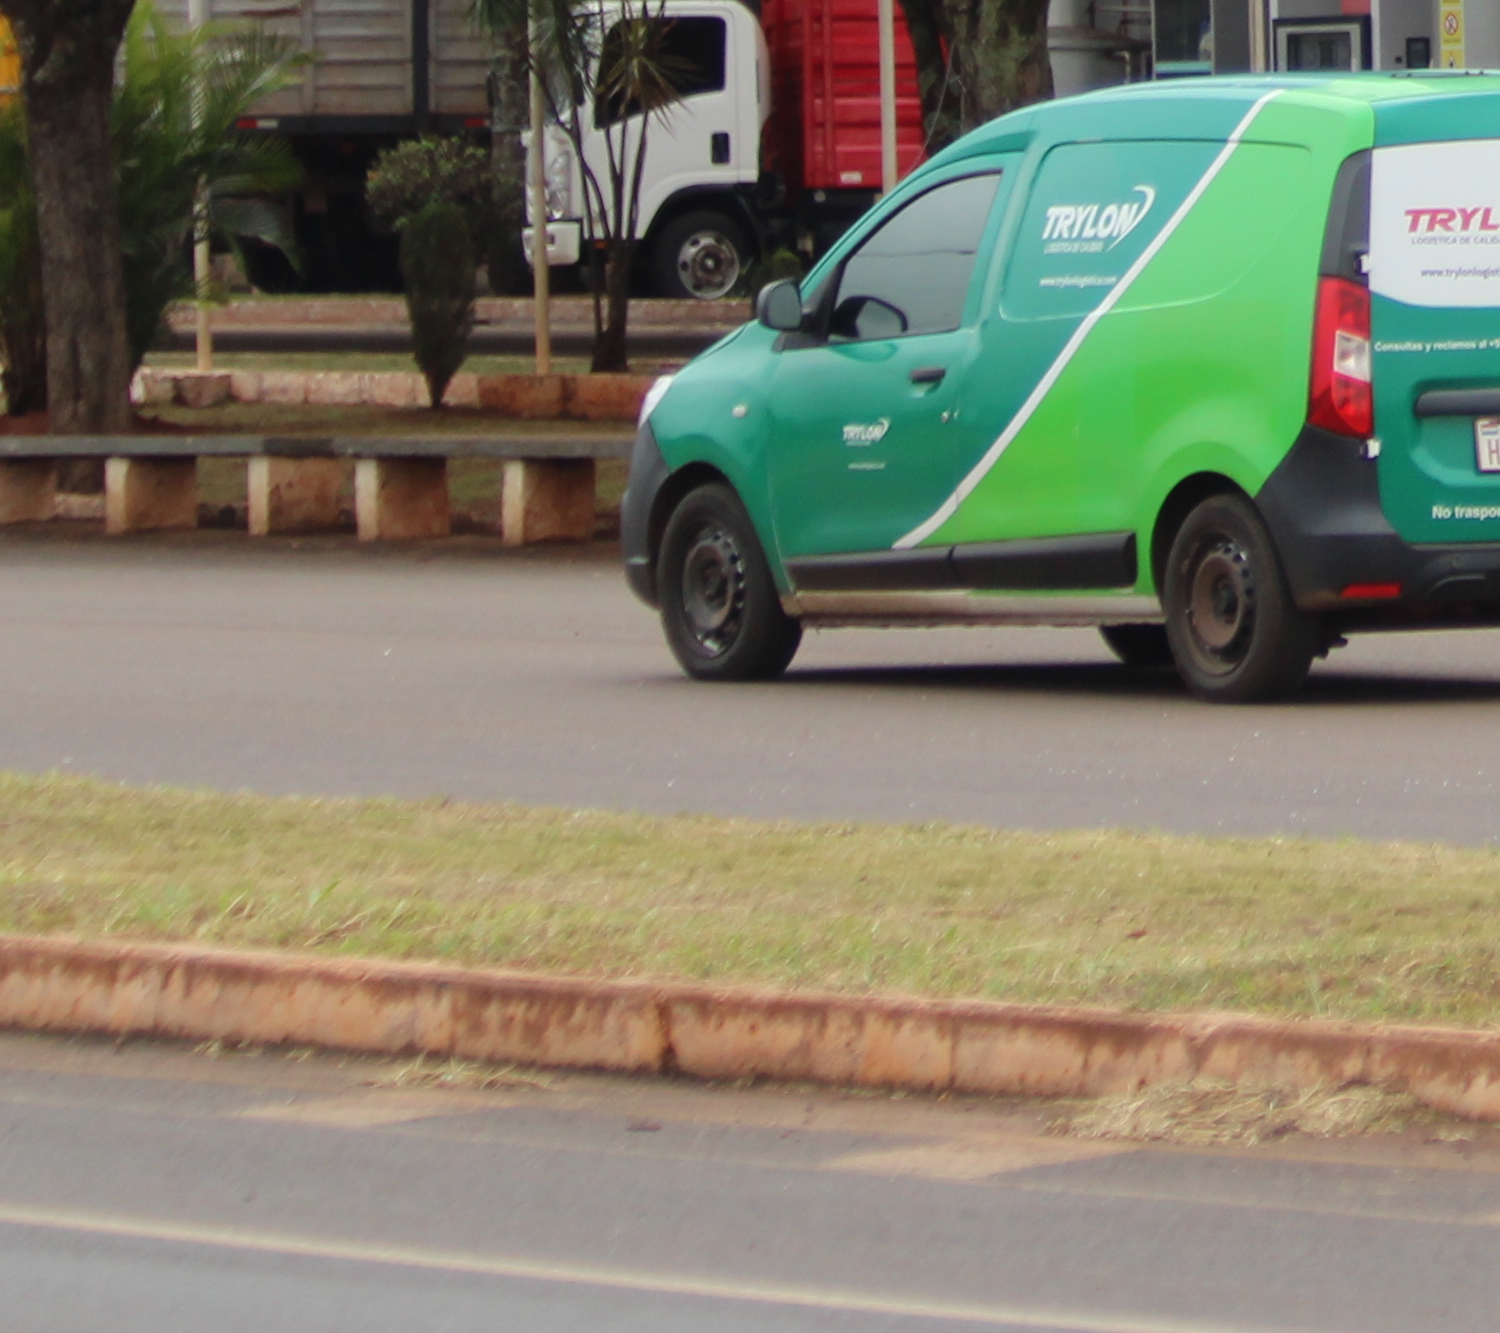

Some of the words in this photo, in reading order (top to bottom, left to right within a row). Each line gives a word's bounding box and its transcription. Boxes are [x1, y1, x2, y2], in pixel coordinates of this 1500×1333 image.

[1042, 204, 1139, 239] TRYLON
[1459, 235, 1472, 244] DE
[1374, 341, 1423, 352] Consultas
[1425, 343, 1432, 353] y
[1433, 340, 1476, 351] reclamos
[1478, 339, 1487, 350] al
[1431, 504, 1450, 519] No
